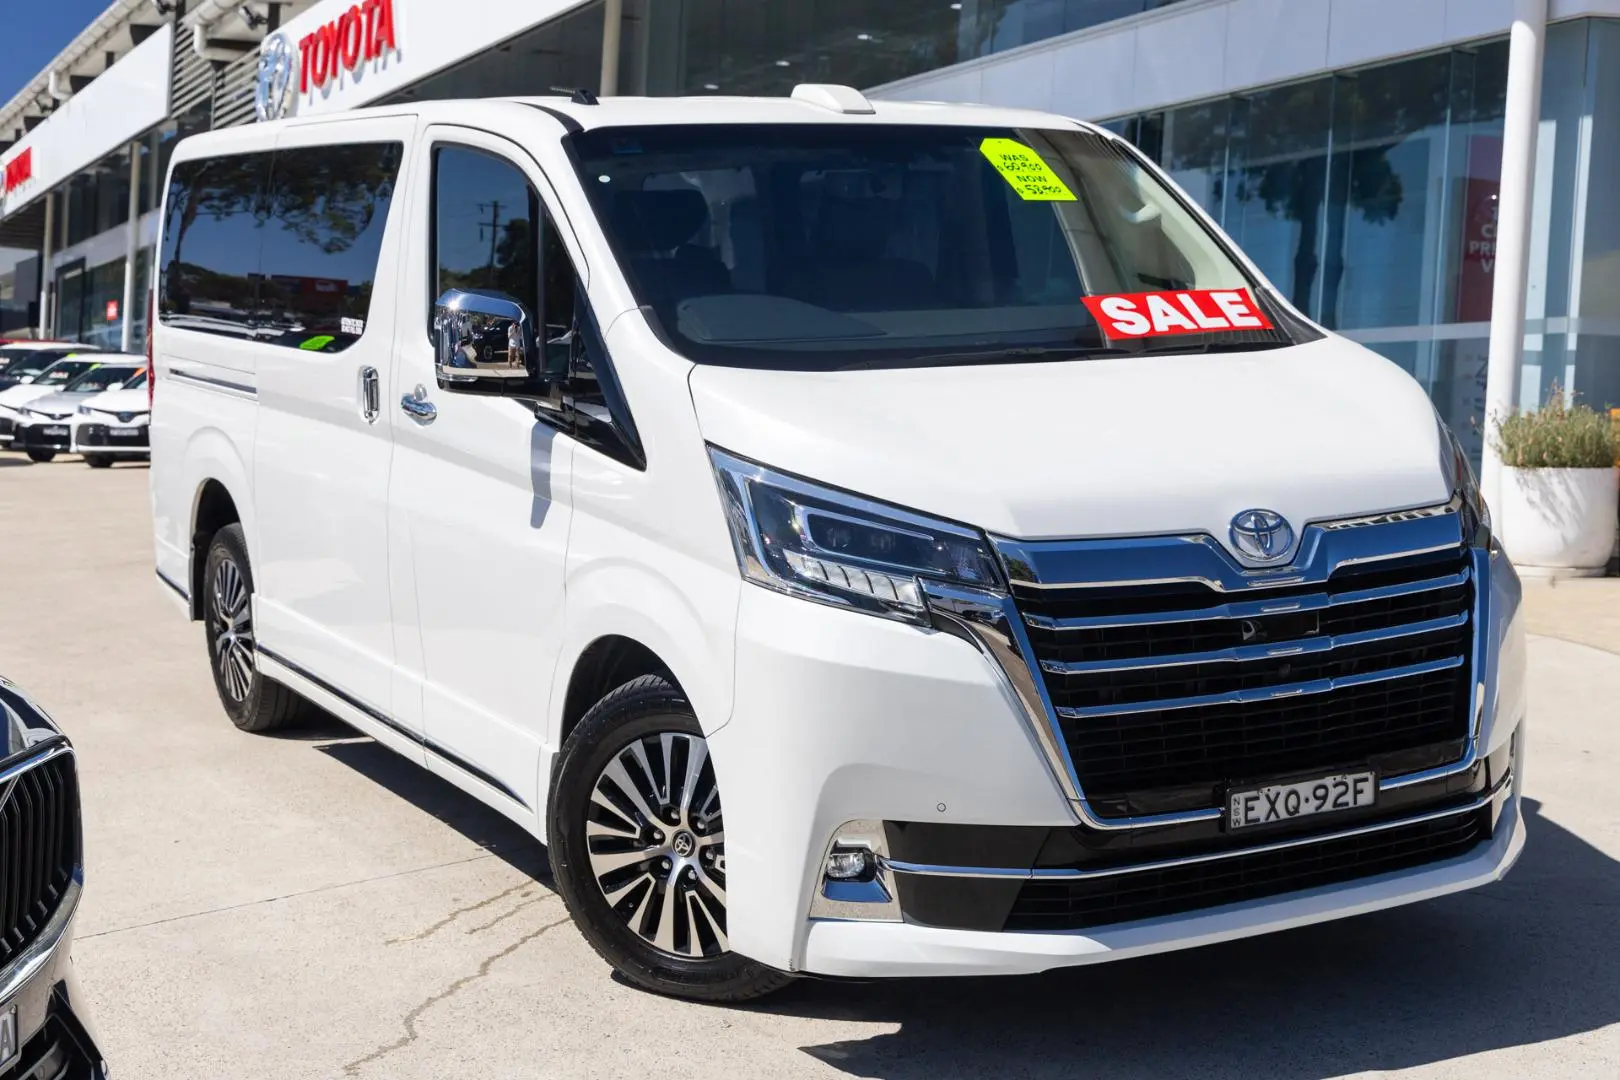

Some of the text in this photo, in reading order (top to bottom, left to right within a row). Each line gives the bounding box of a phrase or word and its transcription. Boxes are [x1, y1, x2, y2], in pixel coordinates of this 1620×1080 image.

[299, 0, 395, 94] TOYOTA
[999, 154, 1029, 162] WAS
[1016, 175, 1047, 183] NOW
[1100, 292, 1262, 335] SALE
[1233, 797, 1241, 827] NSW
